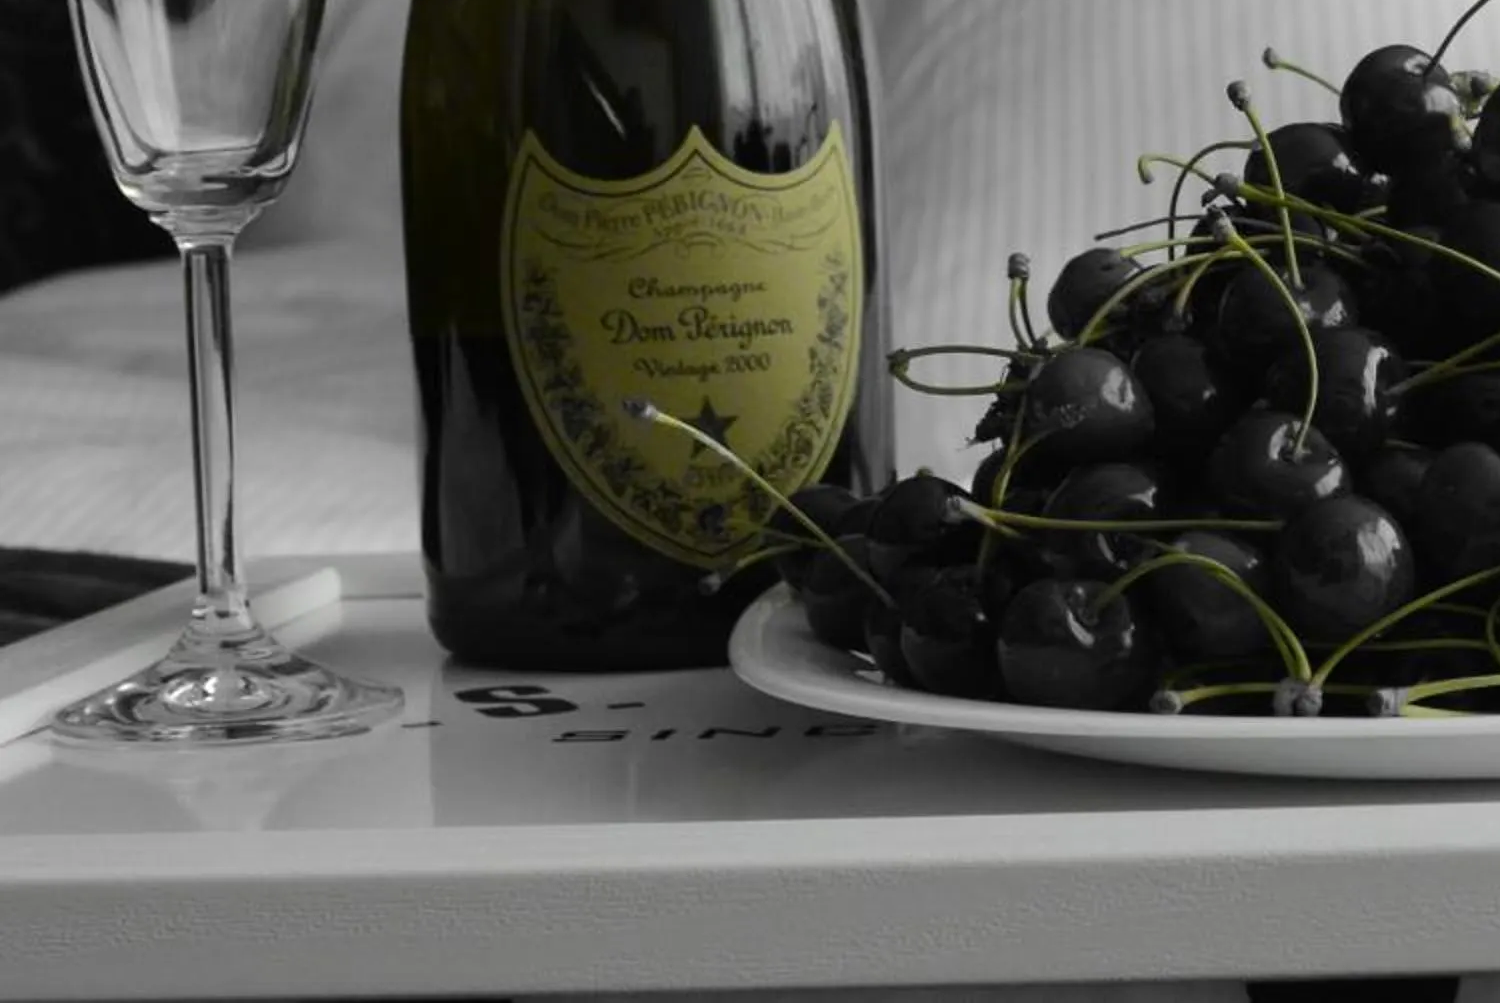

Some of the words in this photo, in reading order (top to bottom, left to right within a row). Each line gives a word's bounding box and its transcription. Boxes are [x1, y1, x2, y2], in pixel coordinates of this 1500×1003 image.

[627, 276, 768, 303] Champagne
[600, 308, 676, 345] Dom
[677, 305, 794, 350] Pérignon
[632, 357, 721, 383] Vintage
[724, 352, 772, 374] 2000
